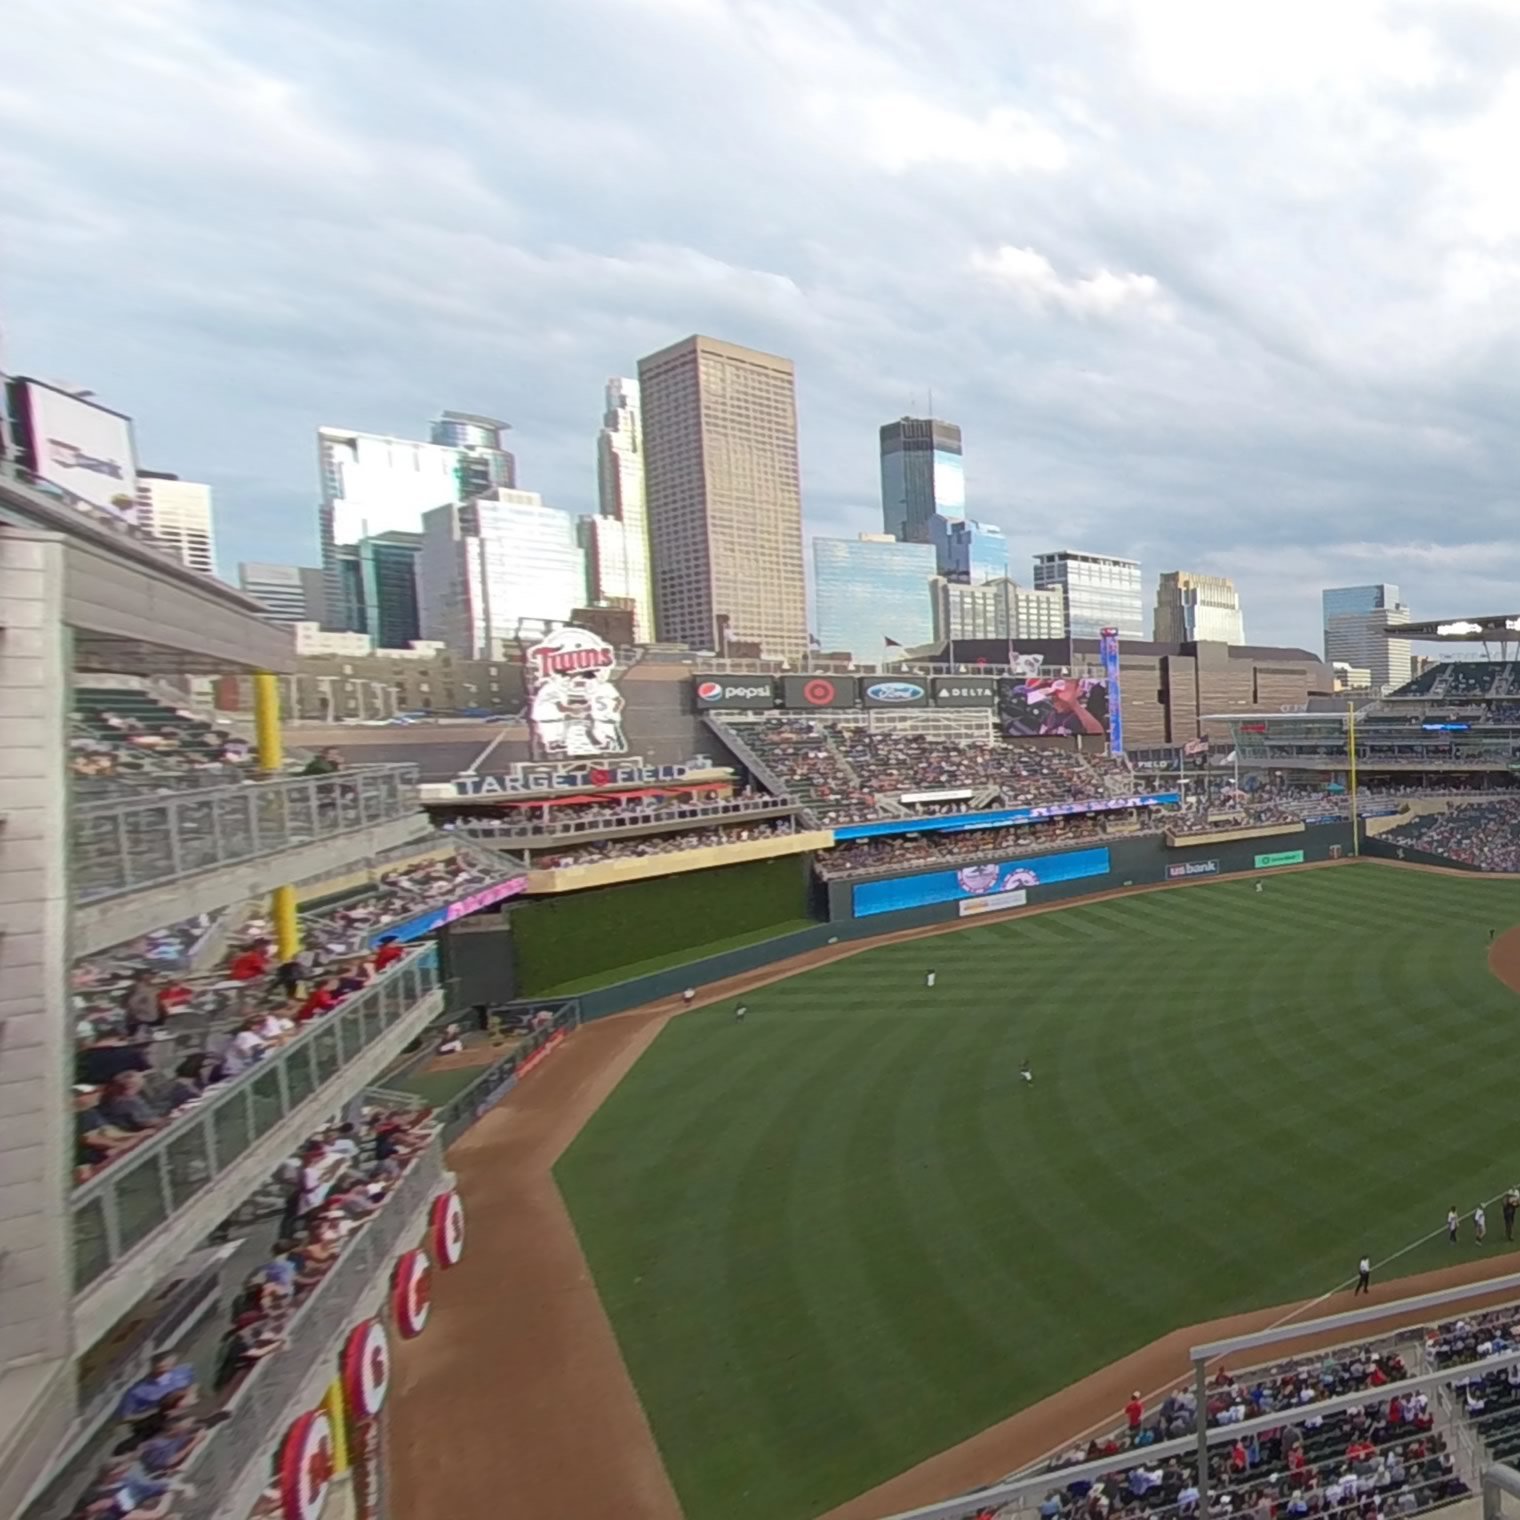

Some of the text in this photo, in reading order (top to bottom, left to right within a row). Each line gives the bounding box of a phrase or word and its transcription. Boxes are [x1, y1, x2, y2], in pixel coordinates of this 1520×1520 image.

[532, 646, 614, 677] Twins
[725, 685, 771, 699] pepsi
[951, 688, 992, 697] DELTA
[452, 763, 688, 795] TARGET FIELD
